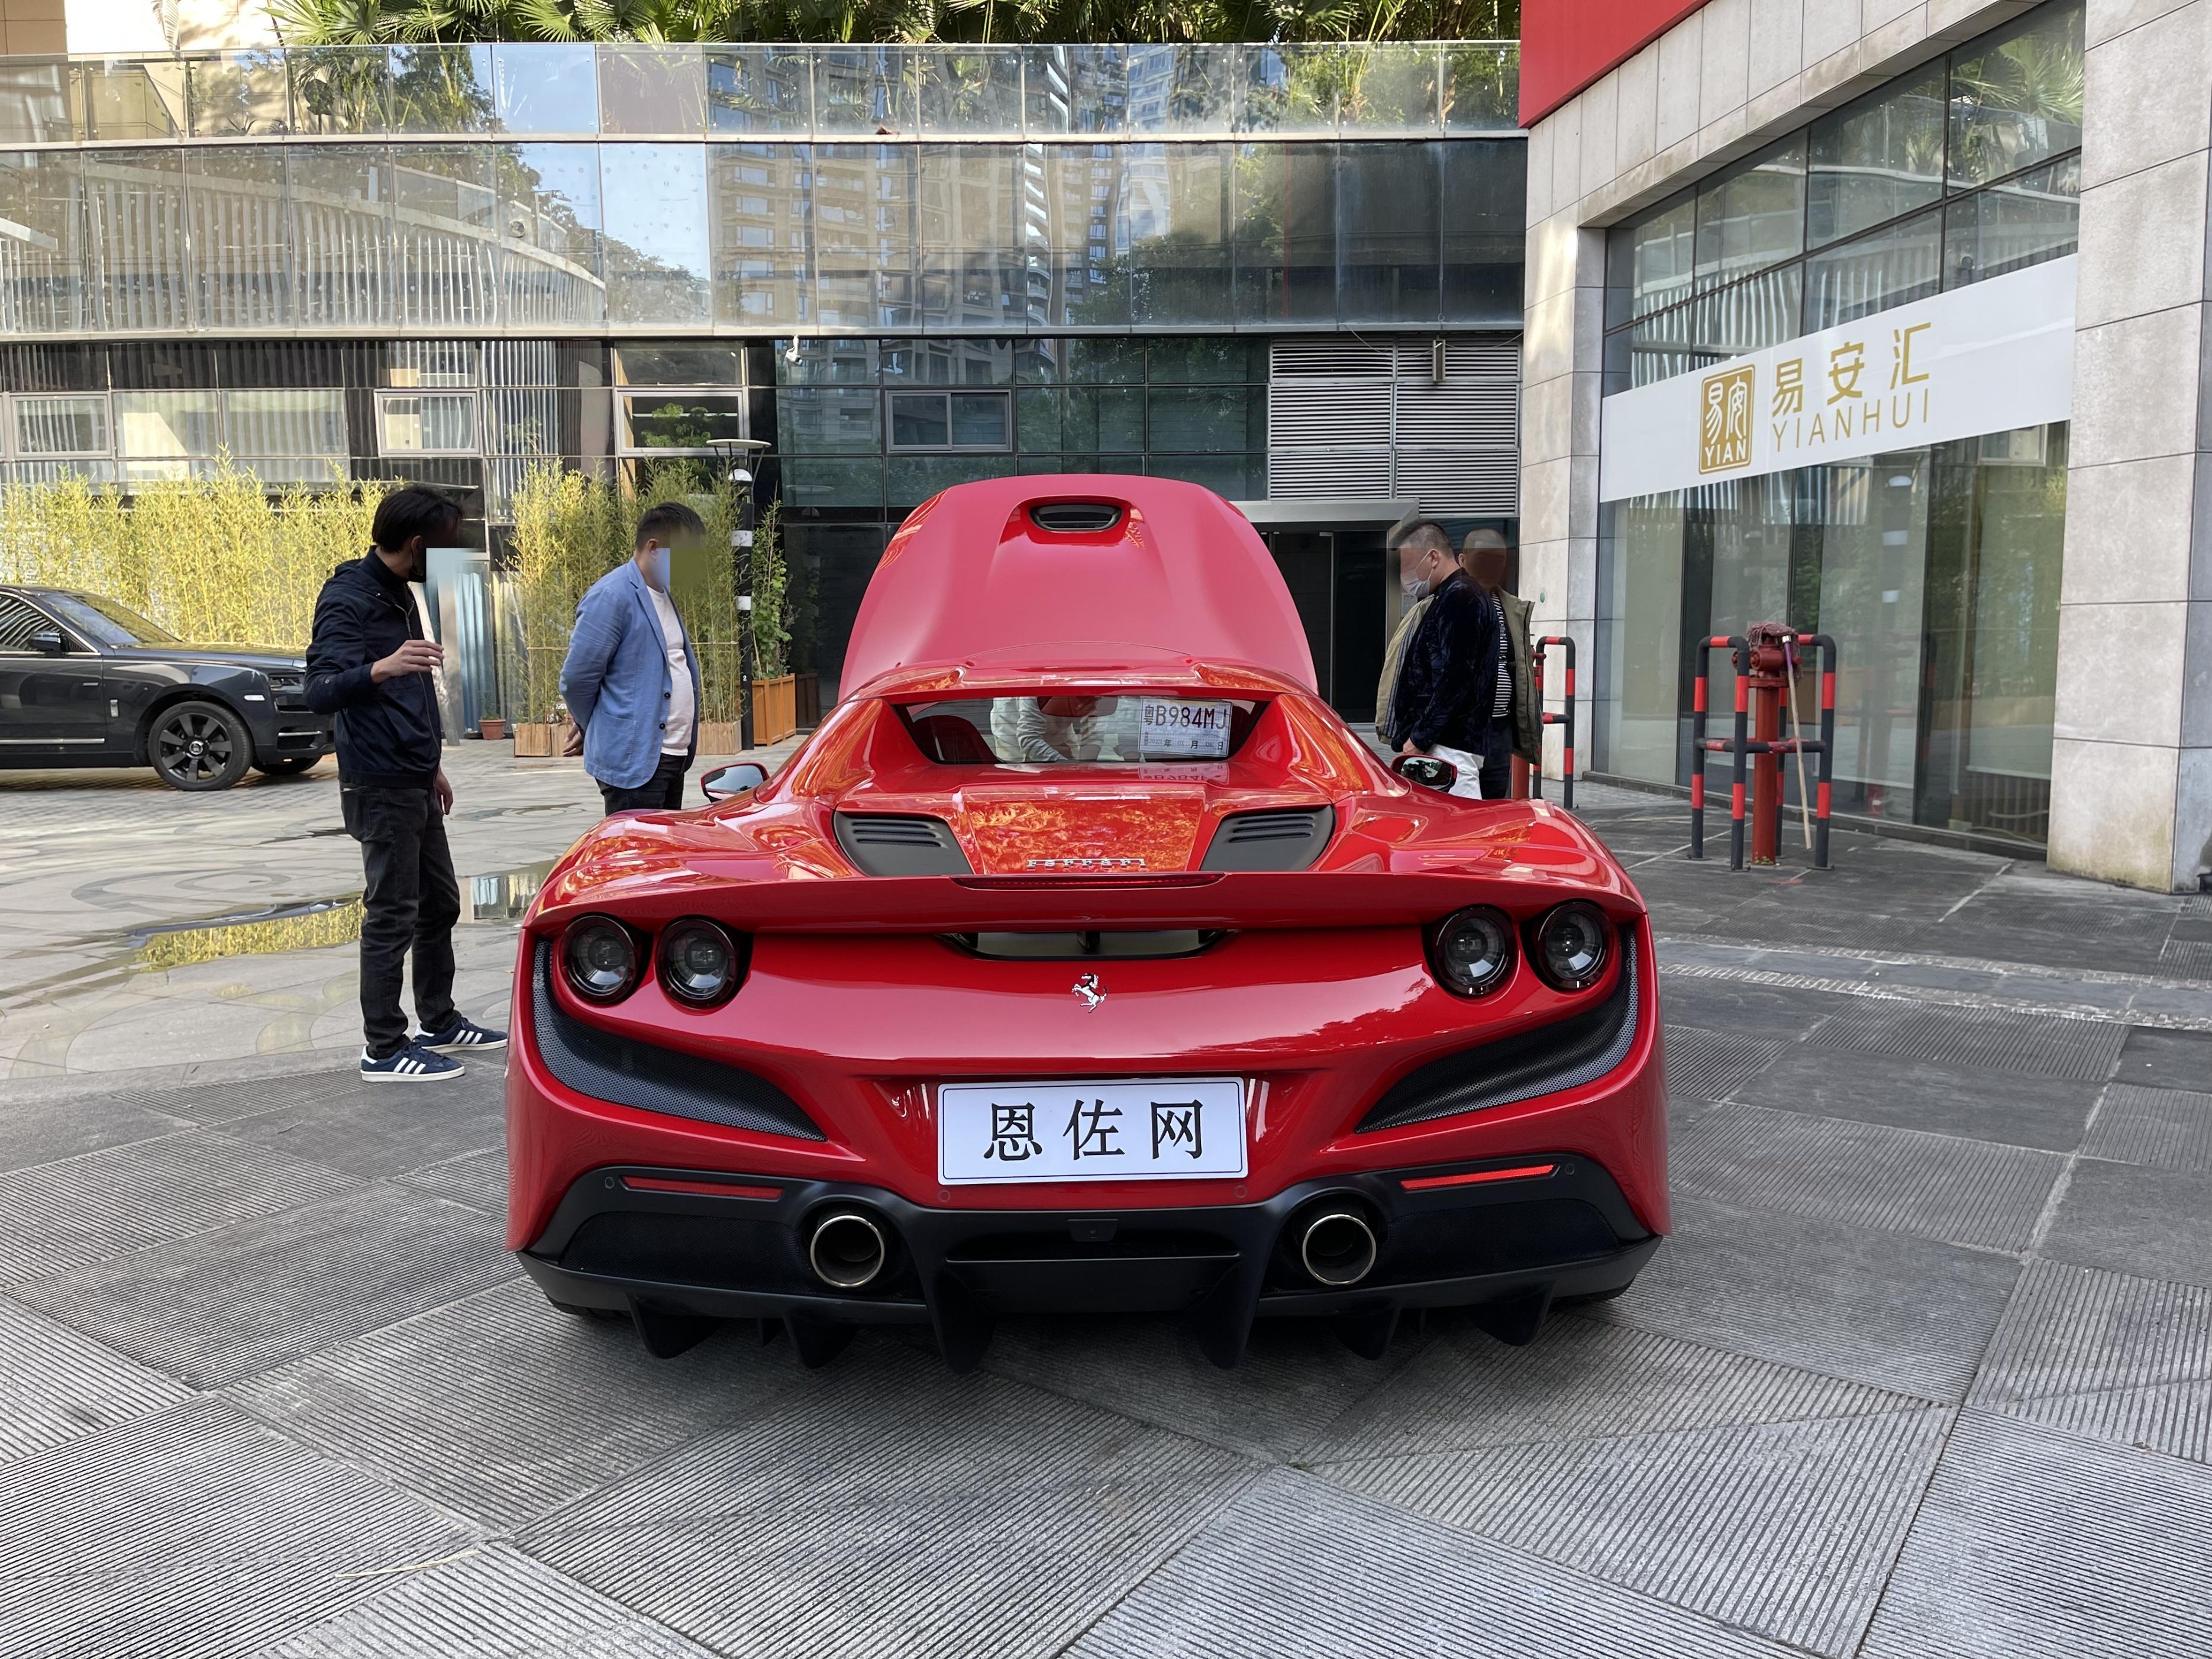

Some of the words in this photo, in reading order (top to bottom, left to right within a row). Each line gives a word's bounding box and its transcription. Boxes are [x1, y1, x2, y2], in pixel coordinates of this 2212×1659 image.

[1772, 322, 1932, 418] 易安汇
[1772, 388, 1929, 453] YIANHUI
[1705, 438, 1746, 466] YIAN
[1144, 705, 1226, 730] 粤B984MJ
[983, 1099, 1203, 1161] 恩佐网
